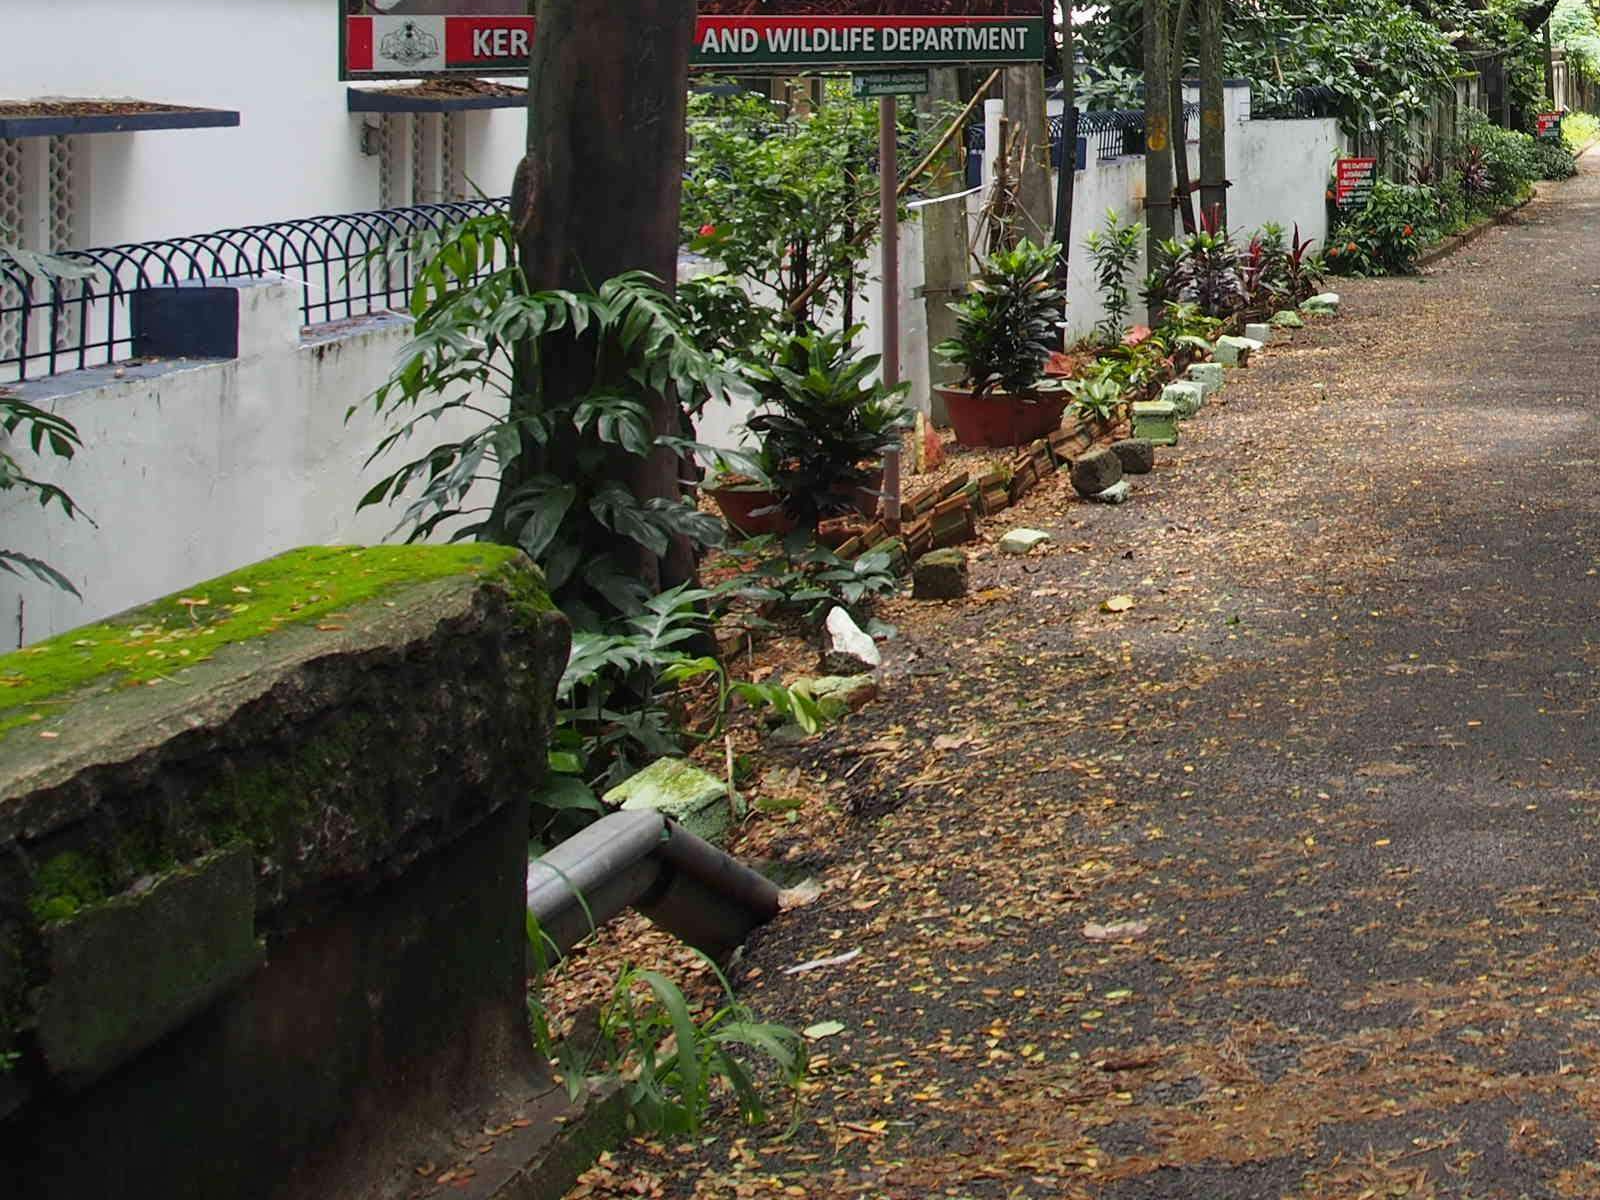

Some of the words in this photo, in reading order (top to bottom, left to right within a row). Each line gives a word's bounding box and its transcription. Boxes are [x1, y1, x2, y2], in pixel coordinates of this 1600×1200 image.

[473, 29, 529, 56] KER
[701, 27, 758, 54] AND
[765, 27, 875, 53] WILDLIFE
[882, 27, 1028, 52] DEPARTMENT
